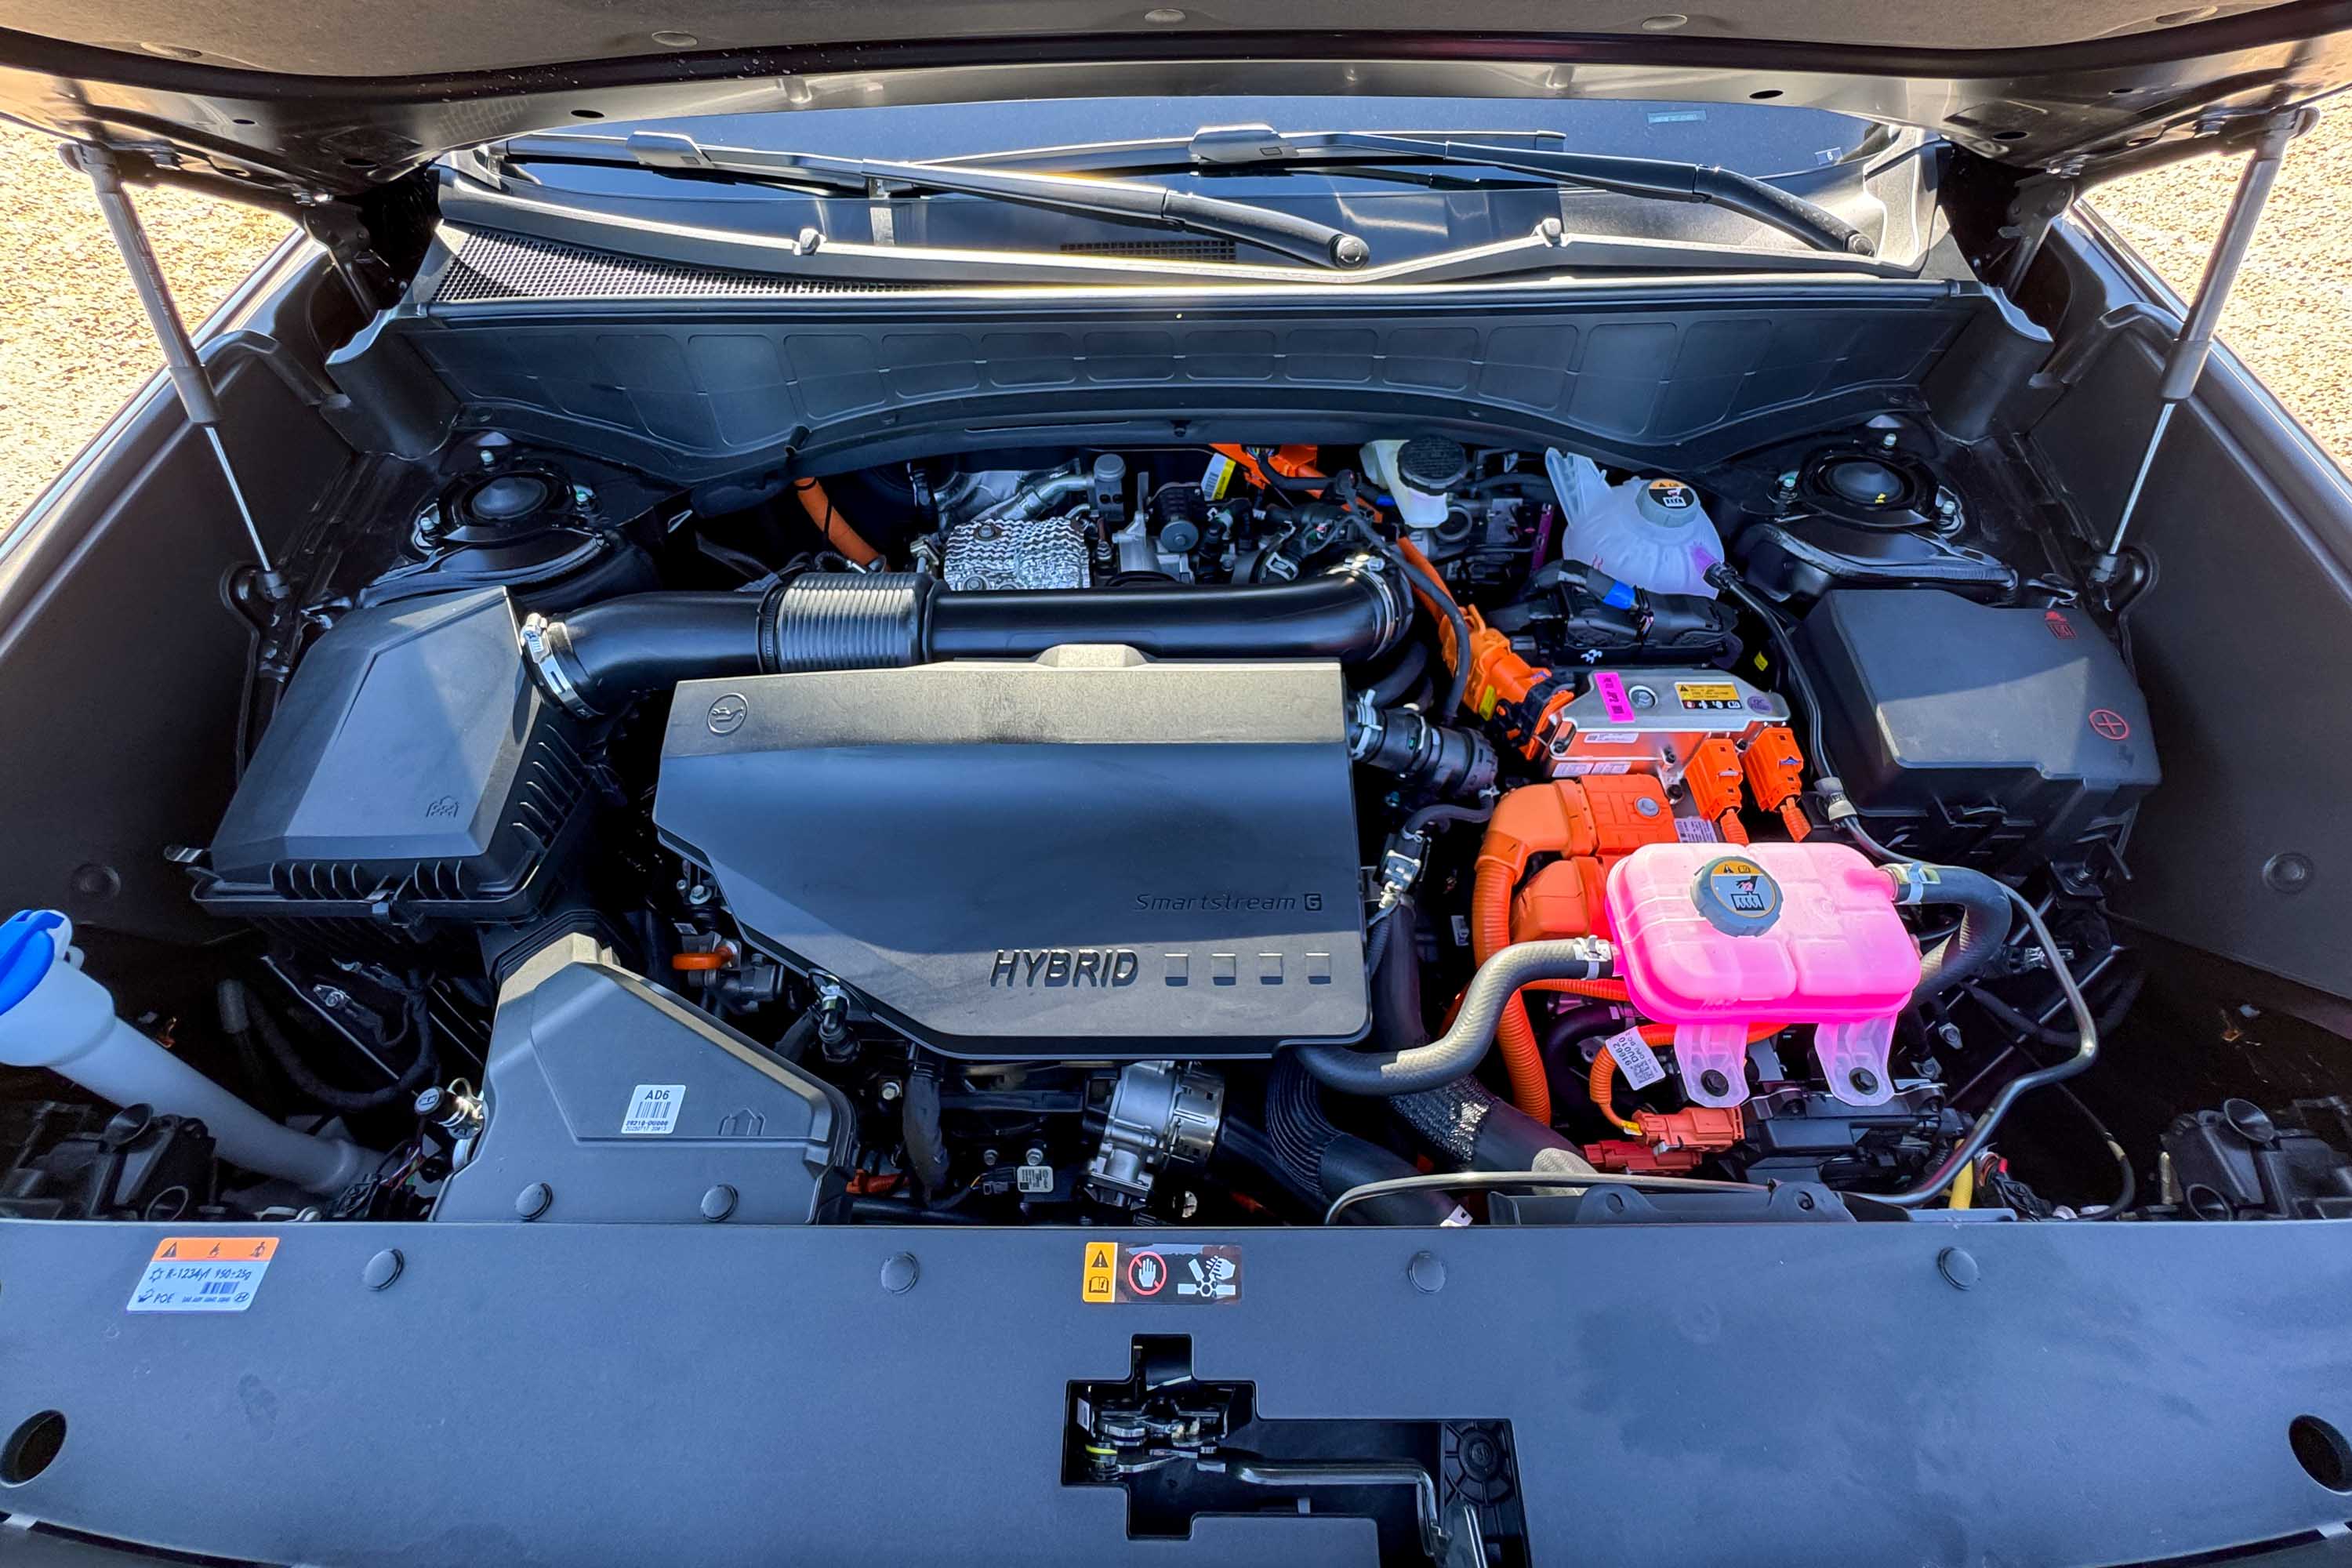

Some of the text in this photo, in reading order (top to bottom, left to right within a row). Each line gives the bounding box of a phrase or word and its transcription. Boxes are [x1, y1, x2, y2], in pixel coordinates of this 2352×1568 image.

[1136, 894, 1294, 910] Smartstream
[990, 949, 1138, 987] HYBRID
[644, 1090, 670, 1100] AD6
